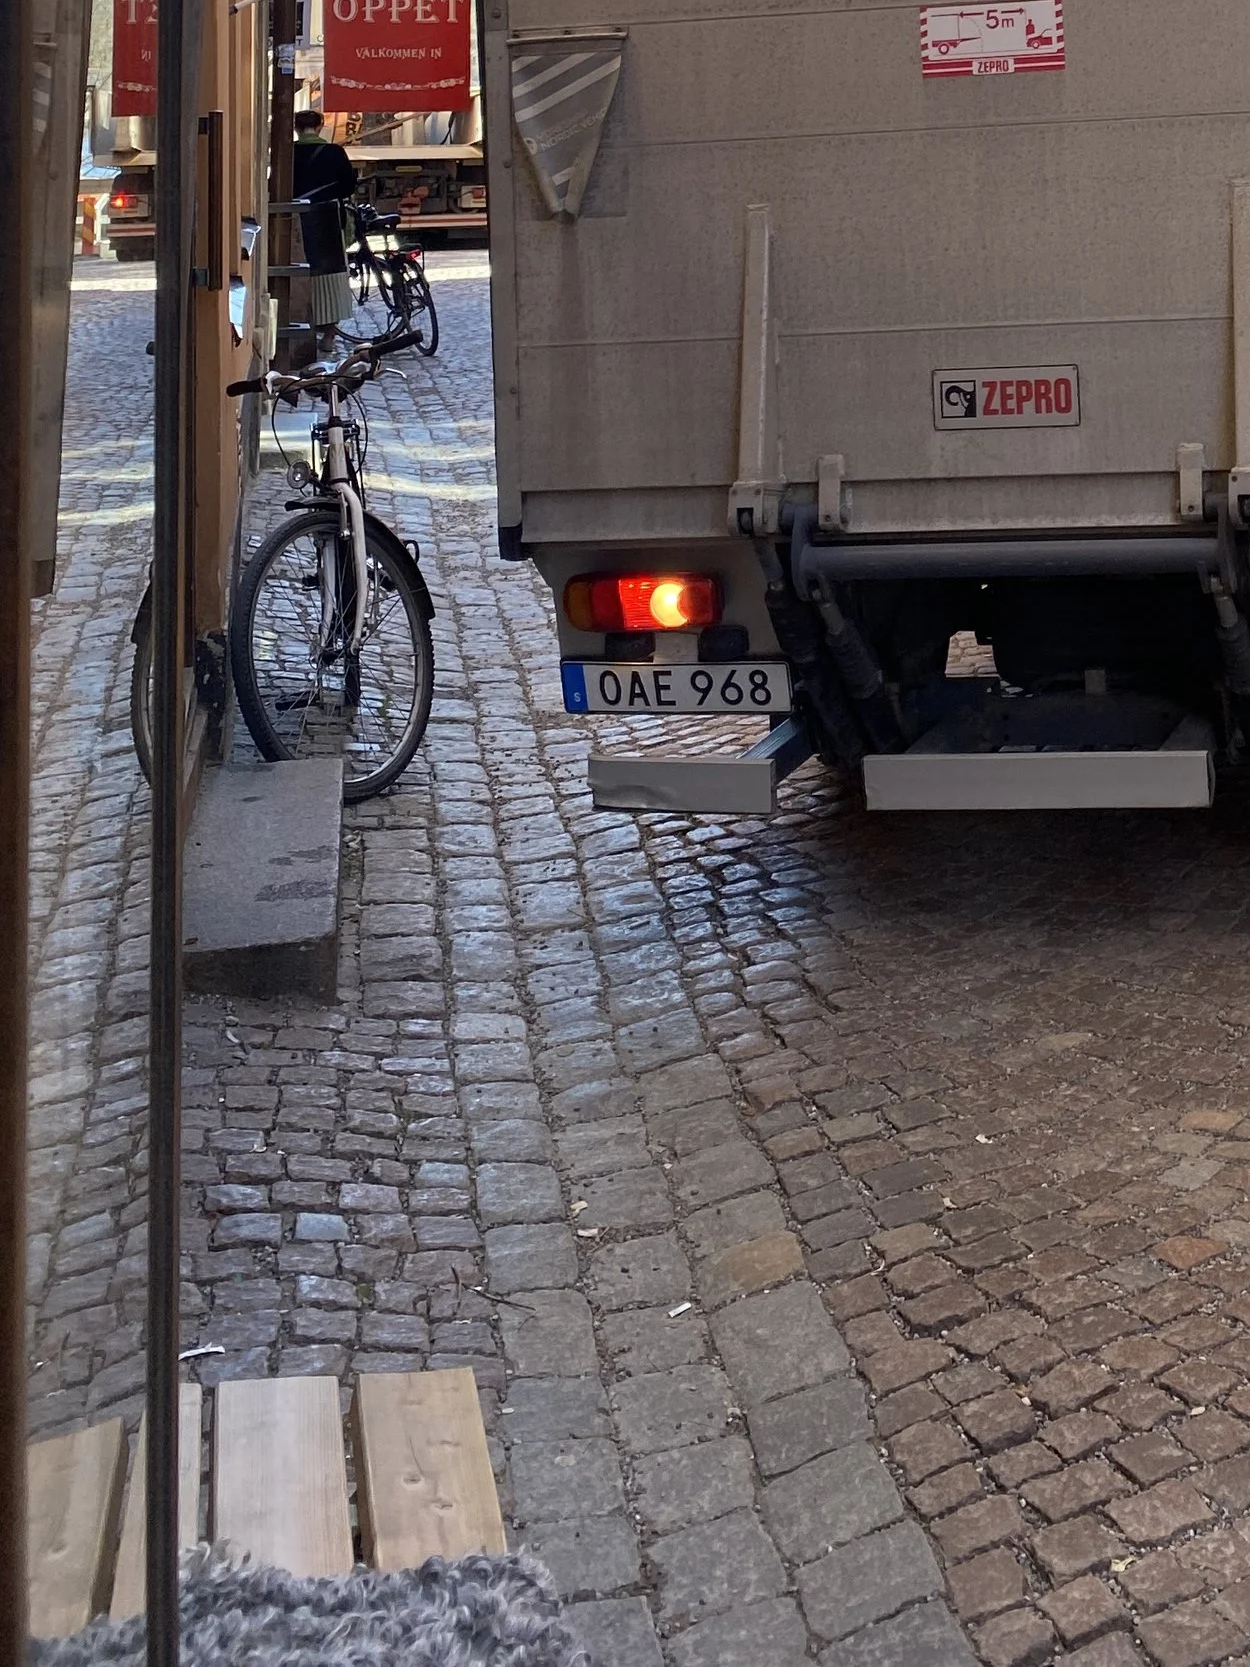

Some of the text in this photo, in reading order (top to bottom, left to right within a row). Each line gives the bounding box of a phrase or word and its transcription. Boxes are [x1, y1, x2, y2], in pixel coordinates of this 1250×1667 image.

[355, 46, 442, 60] VÄLKOMMEN IN
[977, 60, 1010, 74] ZEPRO
[981, 377, 1073, 416] ZEPRO
[573, 669, 772, 707] S OAE 968
